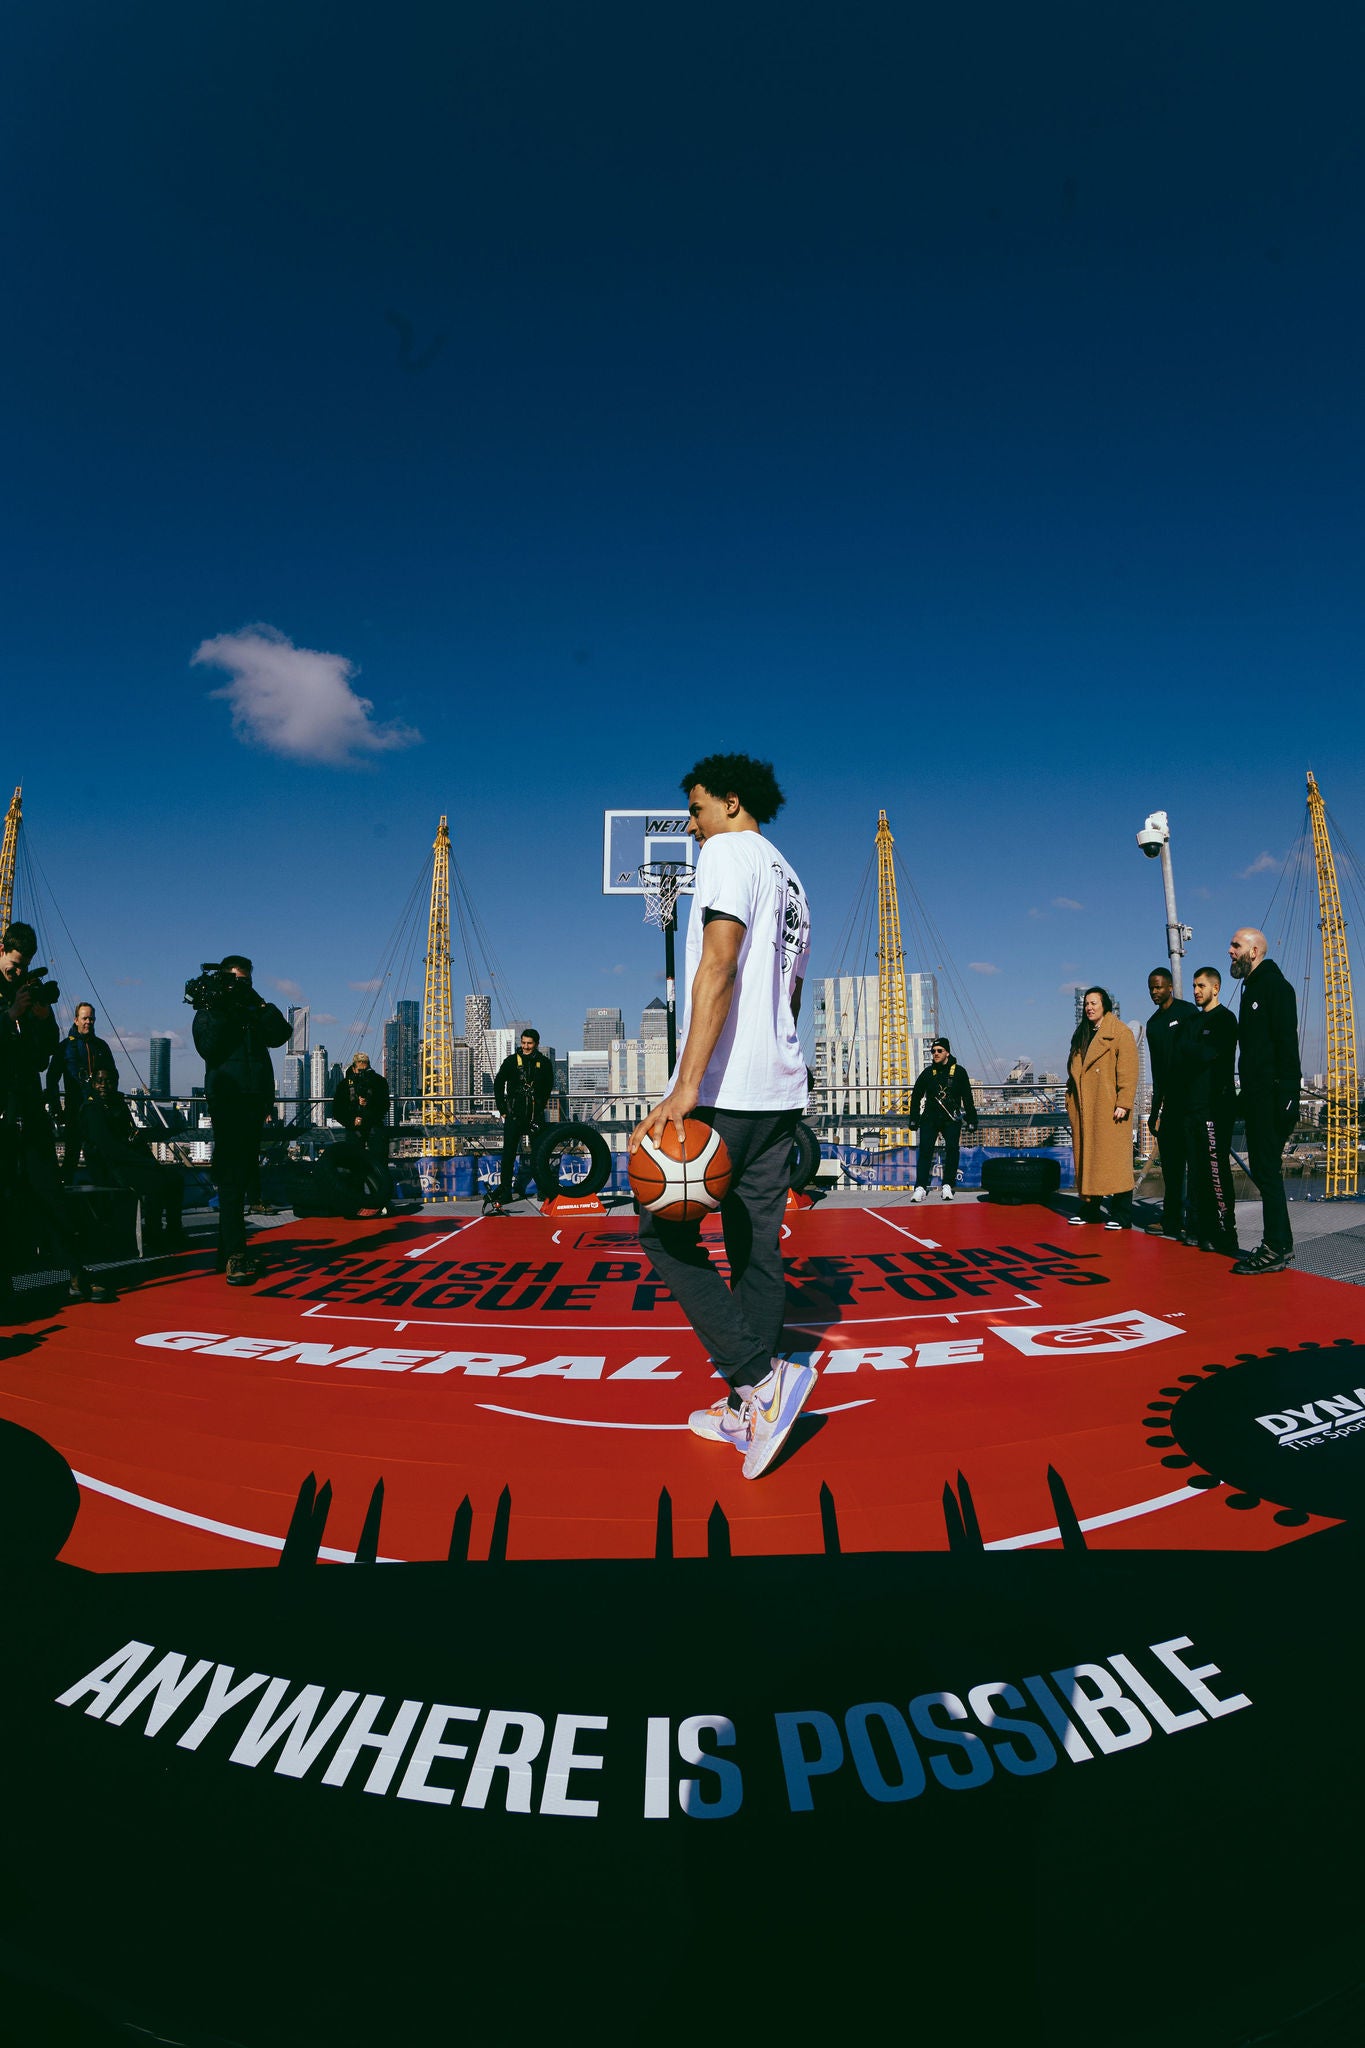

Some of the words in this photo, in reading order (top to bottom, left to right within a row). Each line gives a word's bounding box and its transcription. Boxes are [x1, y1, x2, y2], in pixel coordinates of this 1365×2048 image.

[1205, 1120, 1218, 1159] SIMPLY
[1209, 1160, 1223, 1200] BRITISH
[252, 1276, 601, 1311] LEAGUE
[135, 1331, 682, 1380] GENERAL
[1281, 1436, 1325, 1451] The
[55, 1640, 609, 1817] ANYWHERE
[644, 1715, 743, 1820] IS
[775, 1636, 1253, 1812] POSSIBLE
